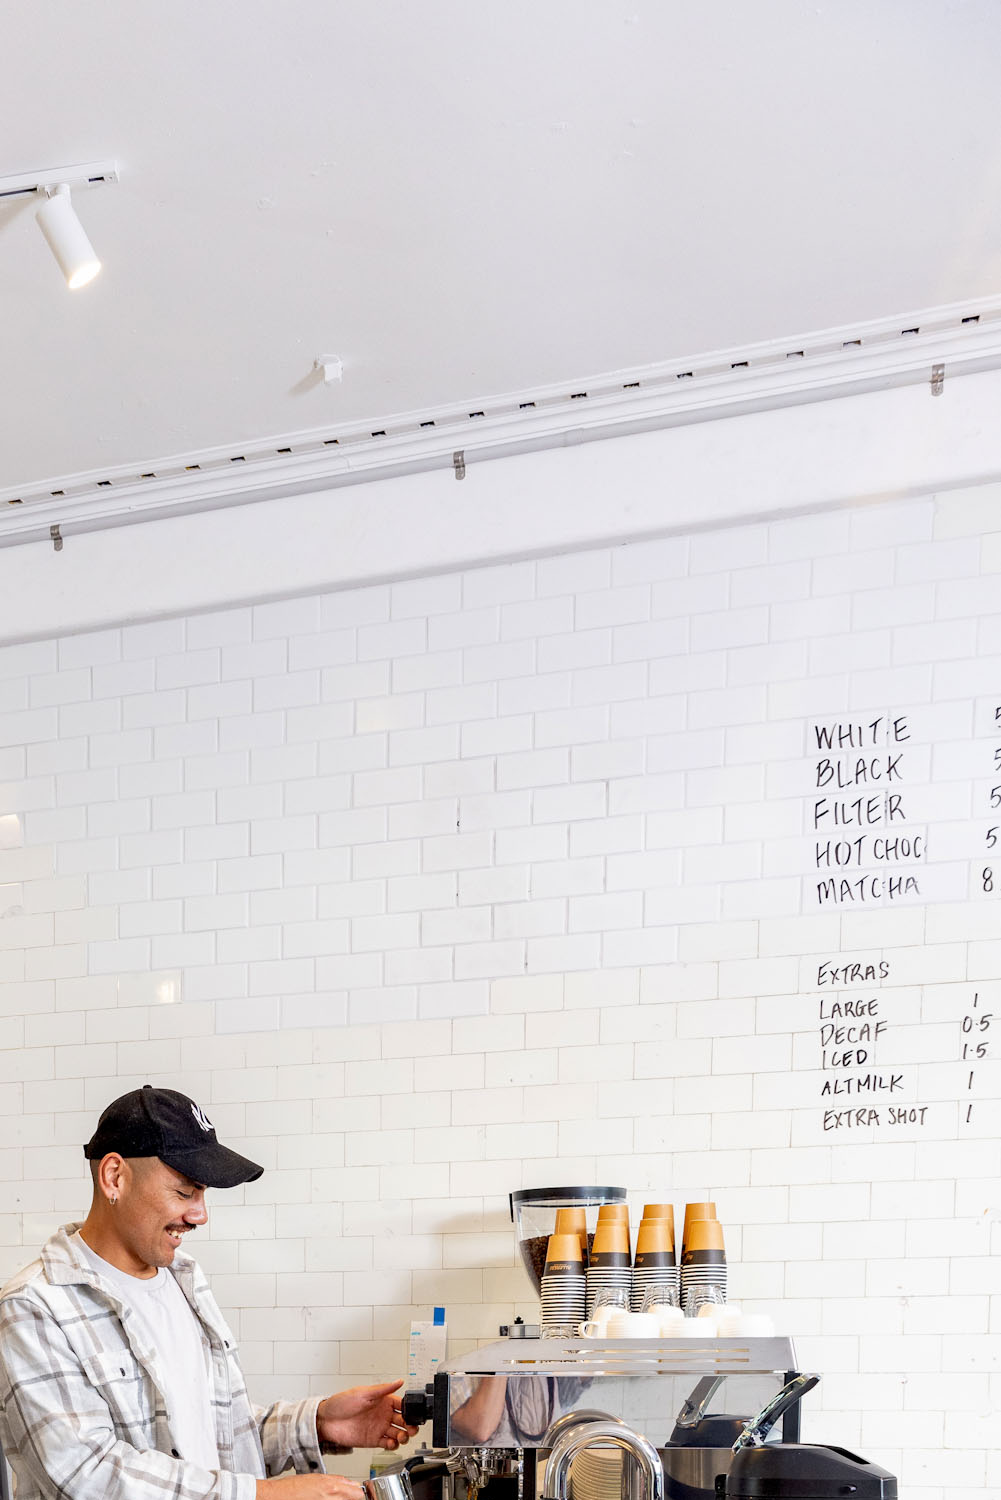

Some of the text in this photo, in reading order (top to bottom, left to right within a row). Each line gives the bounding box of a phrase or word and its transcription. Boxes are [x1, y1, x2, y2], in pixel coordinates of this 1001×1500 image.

[815, 716, 911, 749] WHITE
[816, 753, 904, 788] BLACK
[814, 794, 906, 830] FILTER
[815, 826, 1000, 868] HOT CHOC 5
[817, 875, 921, 904] MATCHA
[817, 961, 890, 986] EXTRAS
[819, 993, 978, 1020] LARGE 1
[820, 1021, 888, 1046] DECAF
[822, 1049, 868, 1070] ICED
[968, 1071, 974, 1090] 1
[823, 1104, 973, 1131] EXTRA SHOT 1
